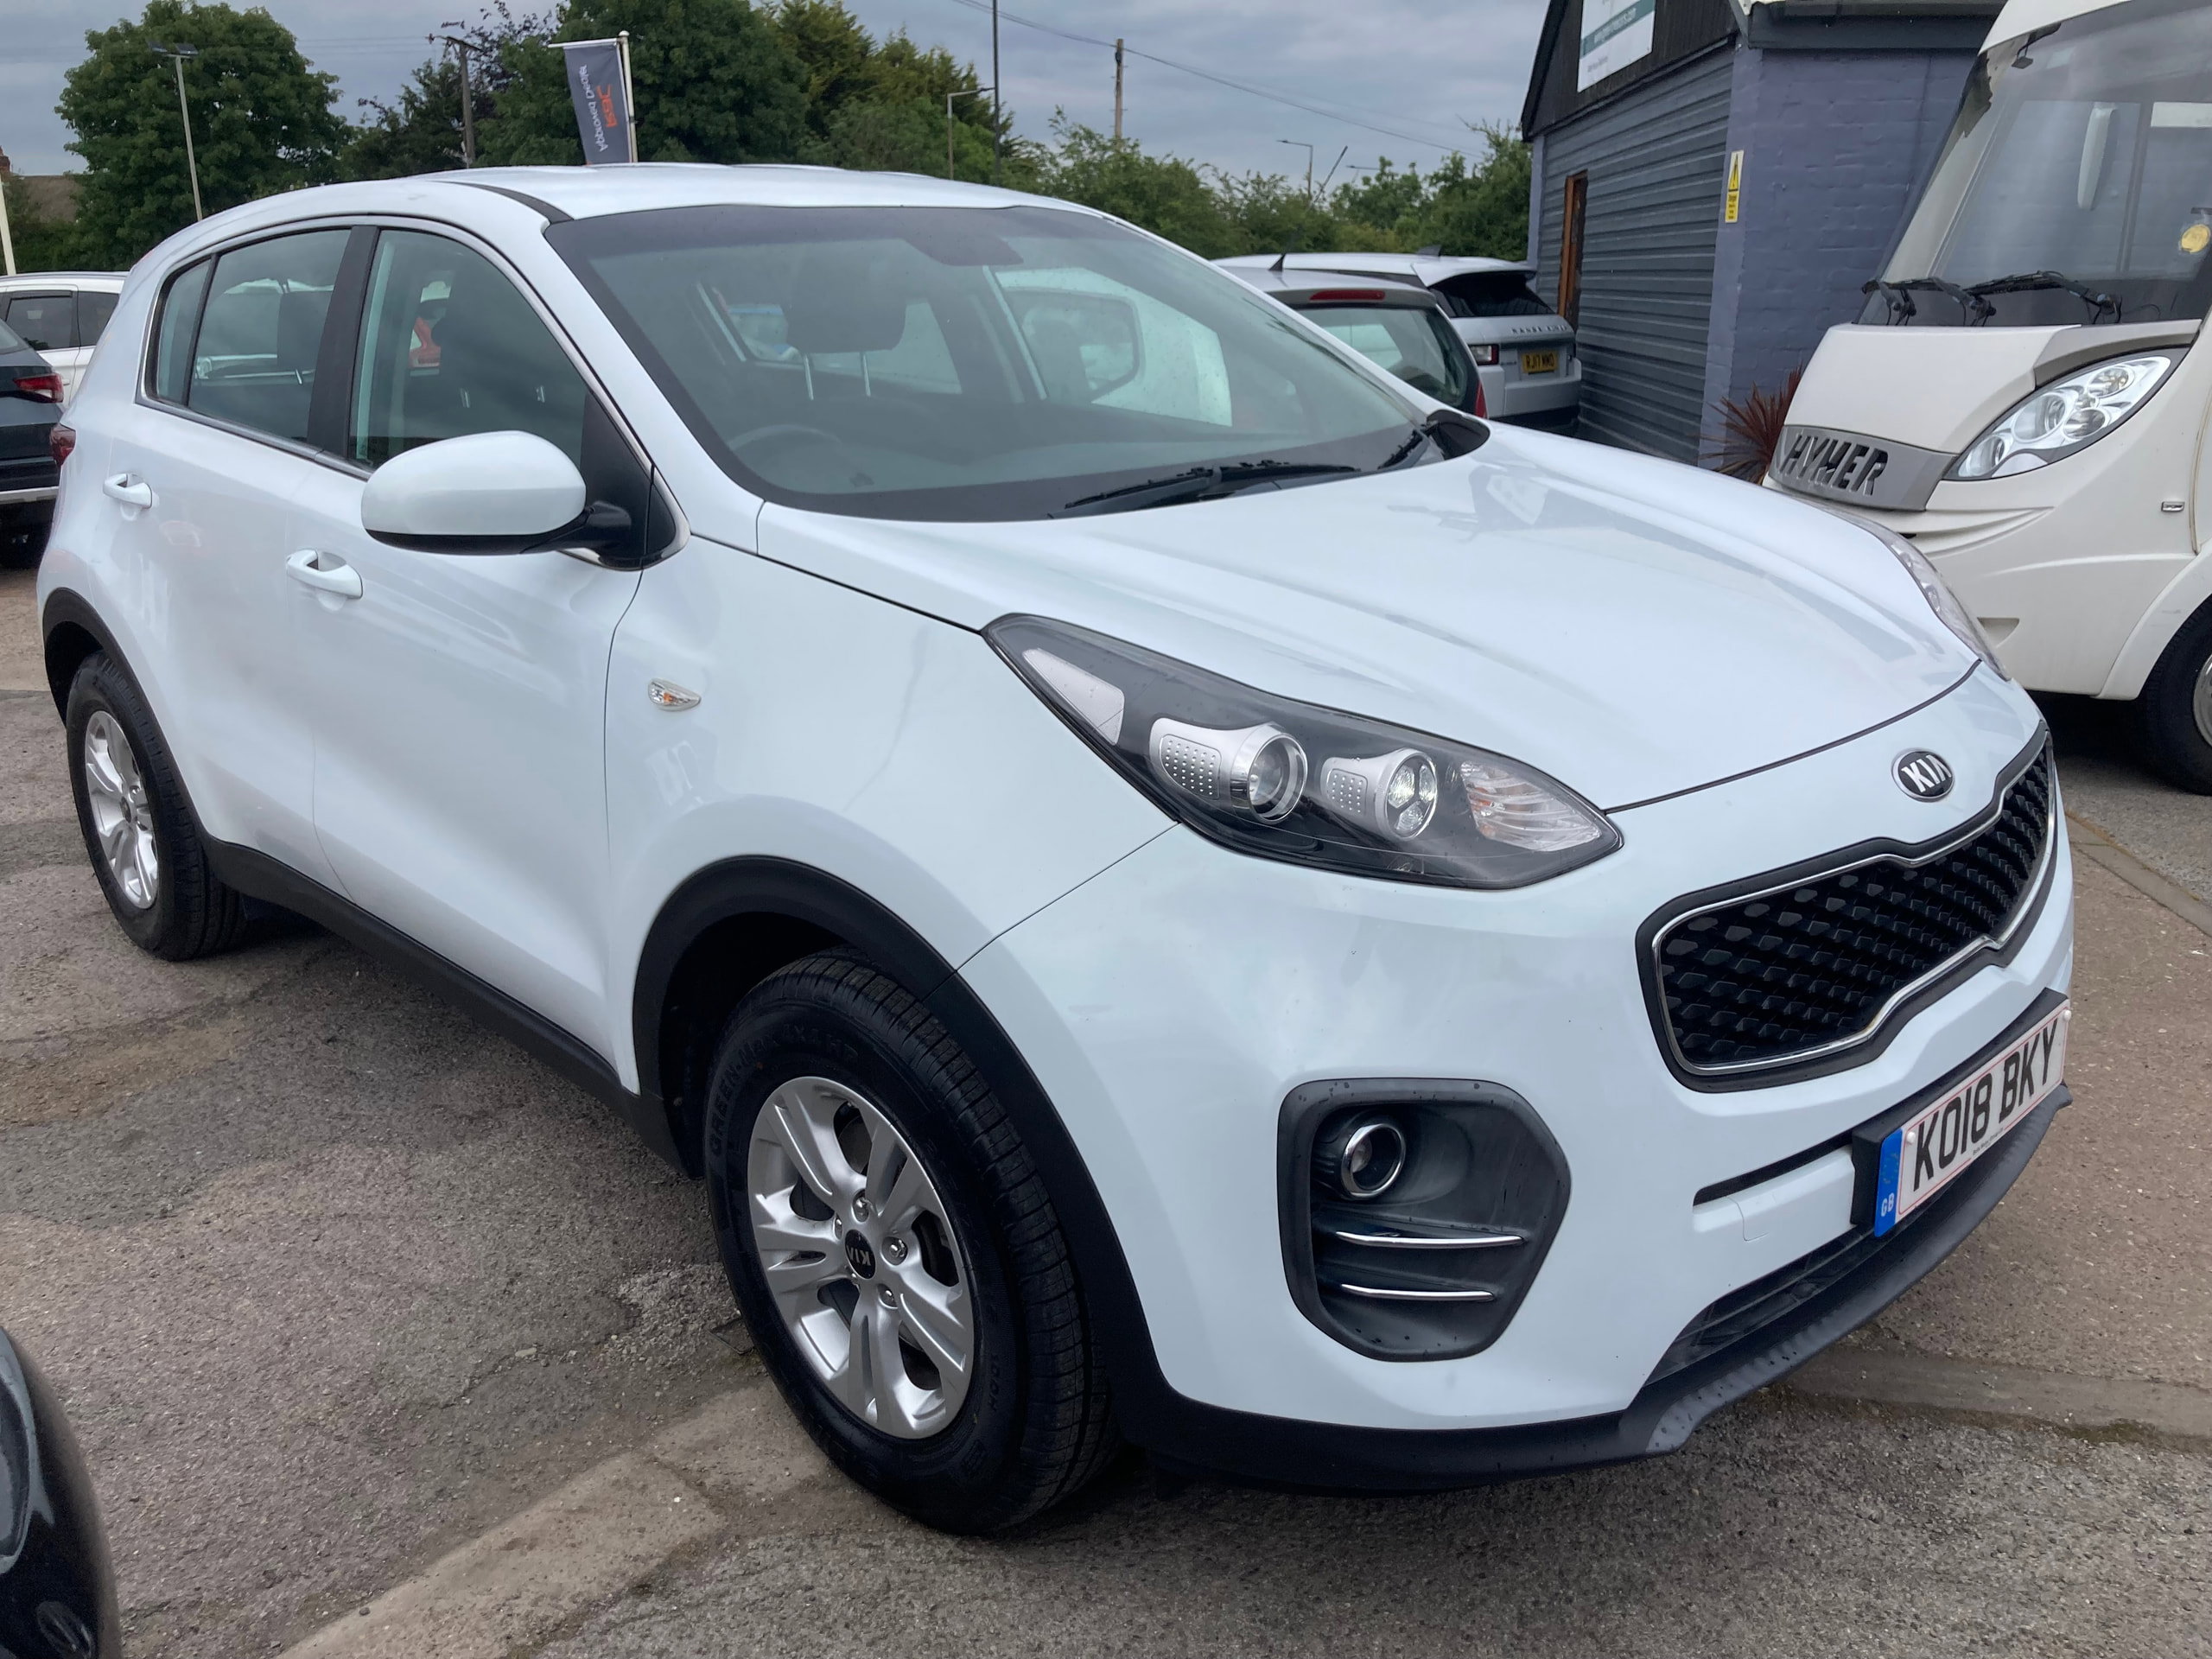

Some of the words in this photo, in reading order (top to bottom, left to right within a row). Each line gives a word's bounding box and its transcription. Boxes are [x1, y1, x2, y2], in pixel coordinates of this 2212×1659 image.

[1779, 433, 1889, 496] HYMER
[1901, 754, 1952, 793] KIA
[1913, 1072, 1993, 1192] KO18
[1999, 1018, 2058, 1124] BKY
[1881, 1192, 1895, 1217] GB
[847, 1245, 872, 1267] KIA
